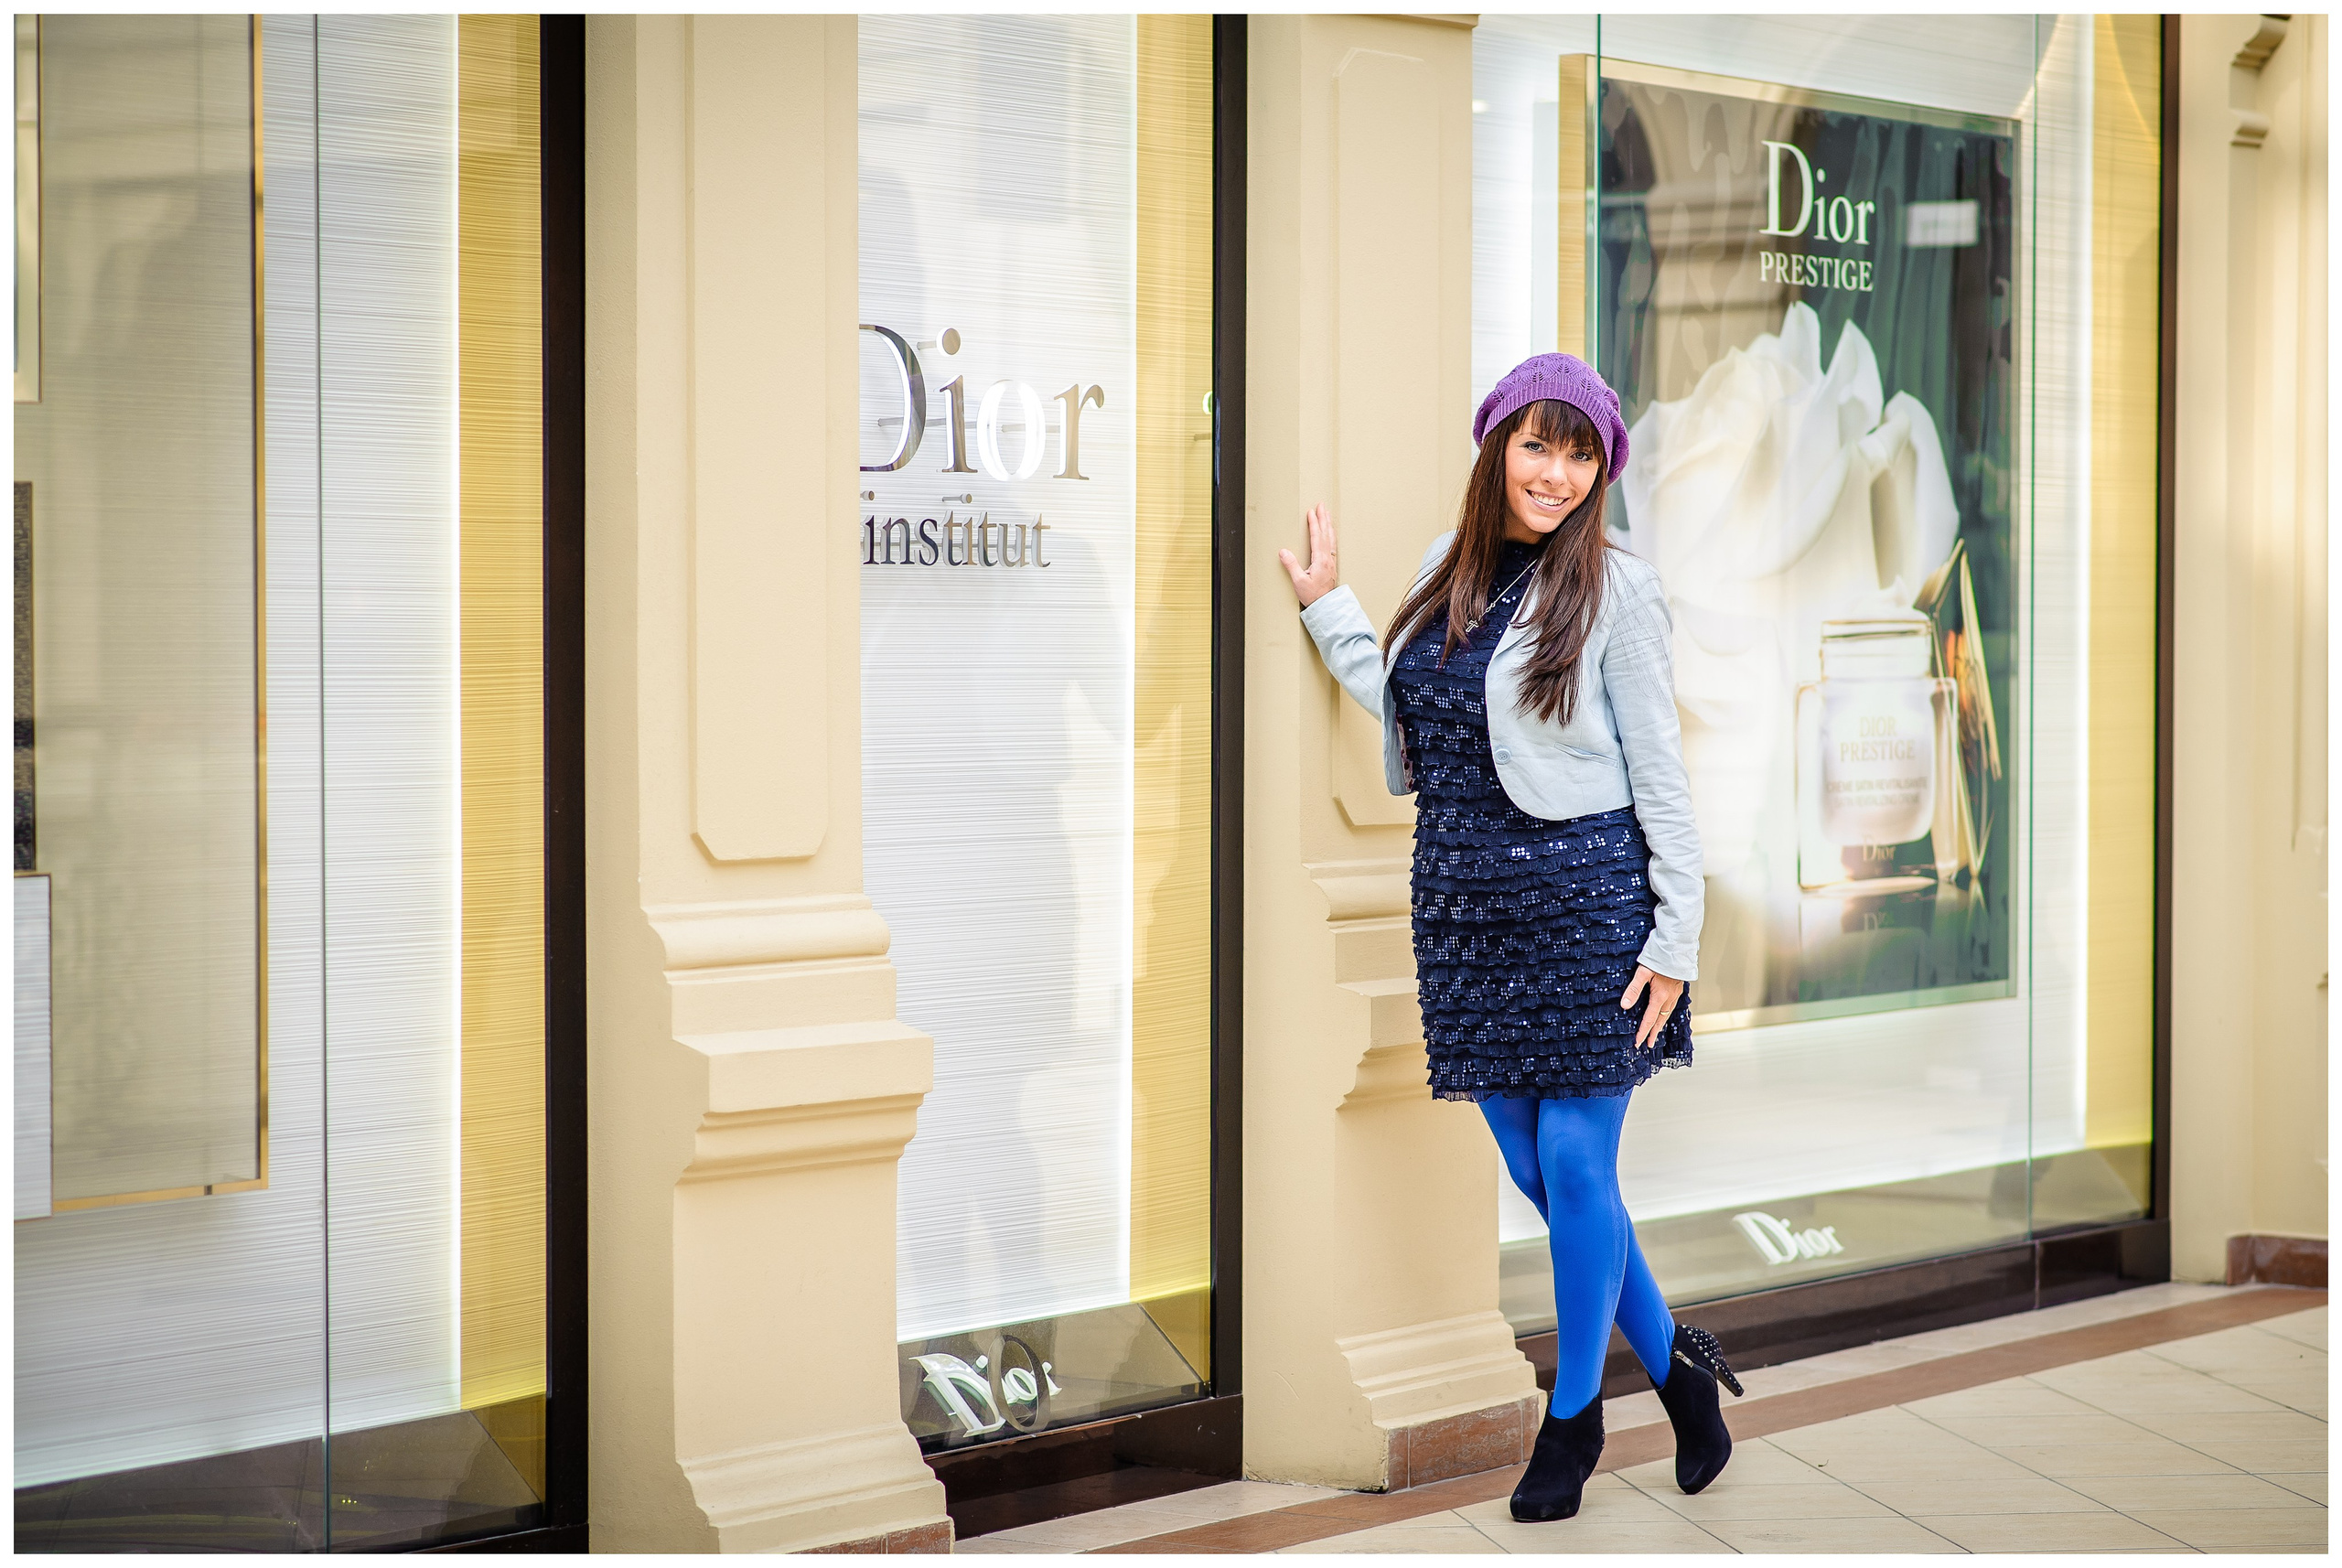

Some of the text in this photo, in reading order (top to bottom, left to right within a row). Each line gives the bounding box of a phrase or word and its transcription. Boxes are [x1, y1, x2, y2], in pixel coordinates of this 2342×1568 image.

[1759, 140, 1875, 245] Dior
[1759, 251, 1873, 292] PRESTIGE
[860, 489, 1051, 568] institut
[1859, 715, 1897, 737] DIOR
[1840, 738, 1916, 762] PRESTIGE
[1863, 833, 1896, 861] Dior
[1732, 1211, 1844, 1265] Dior
